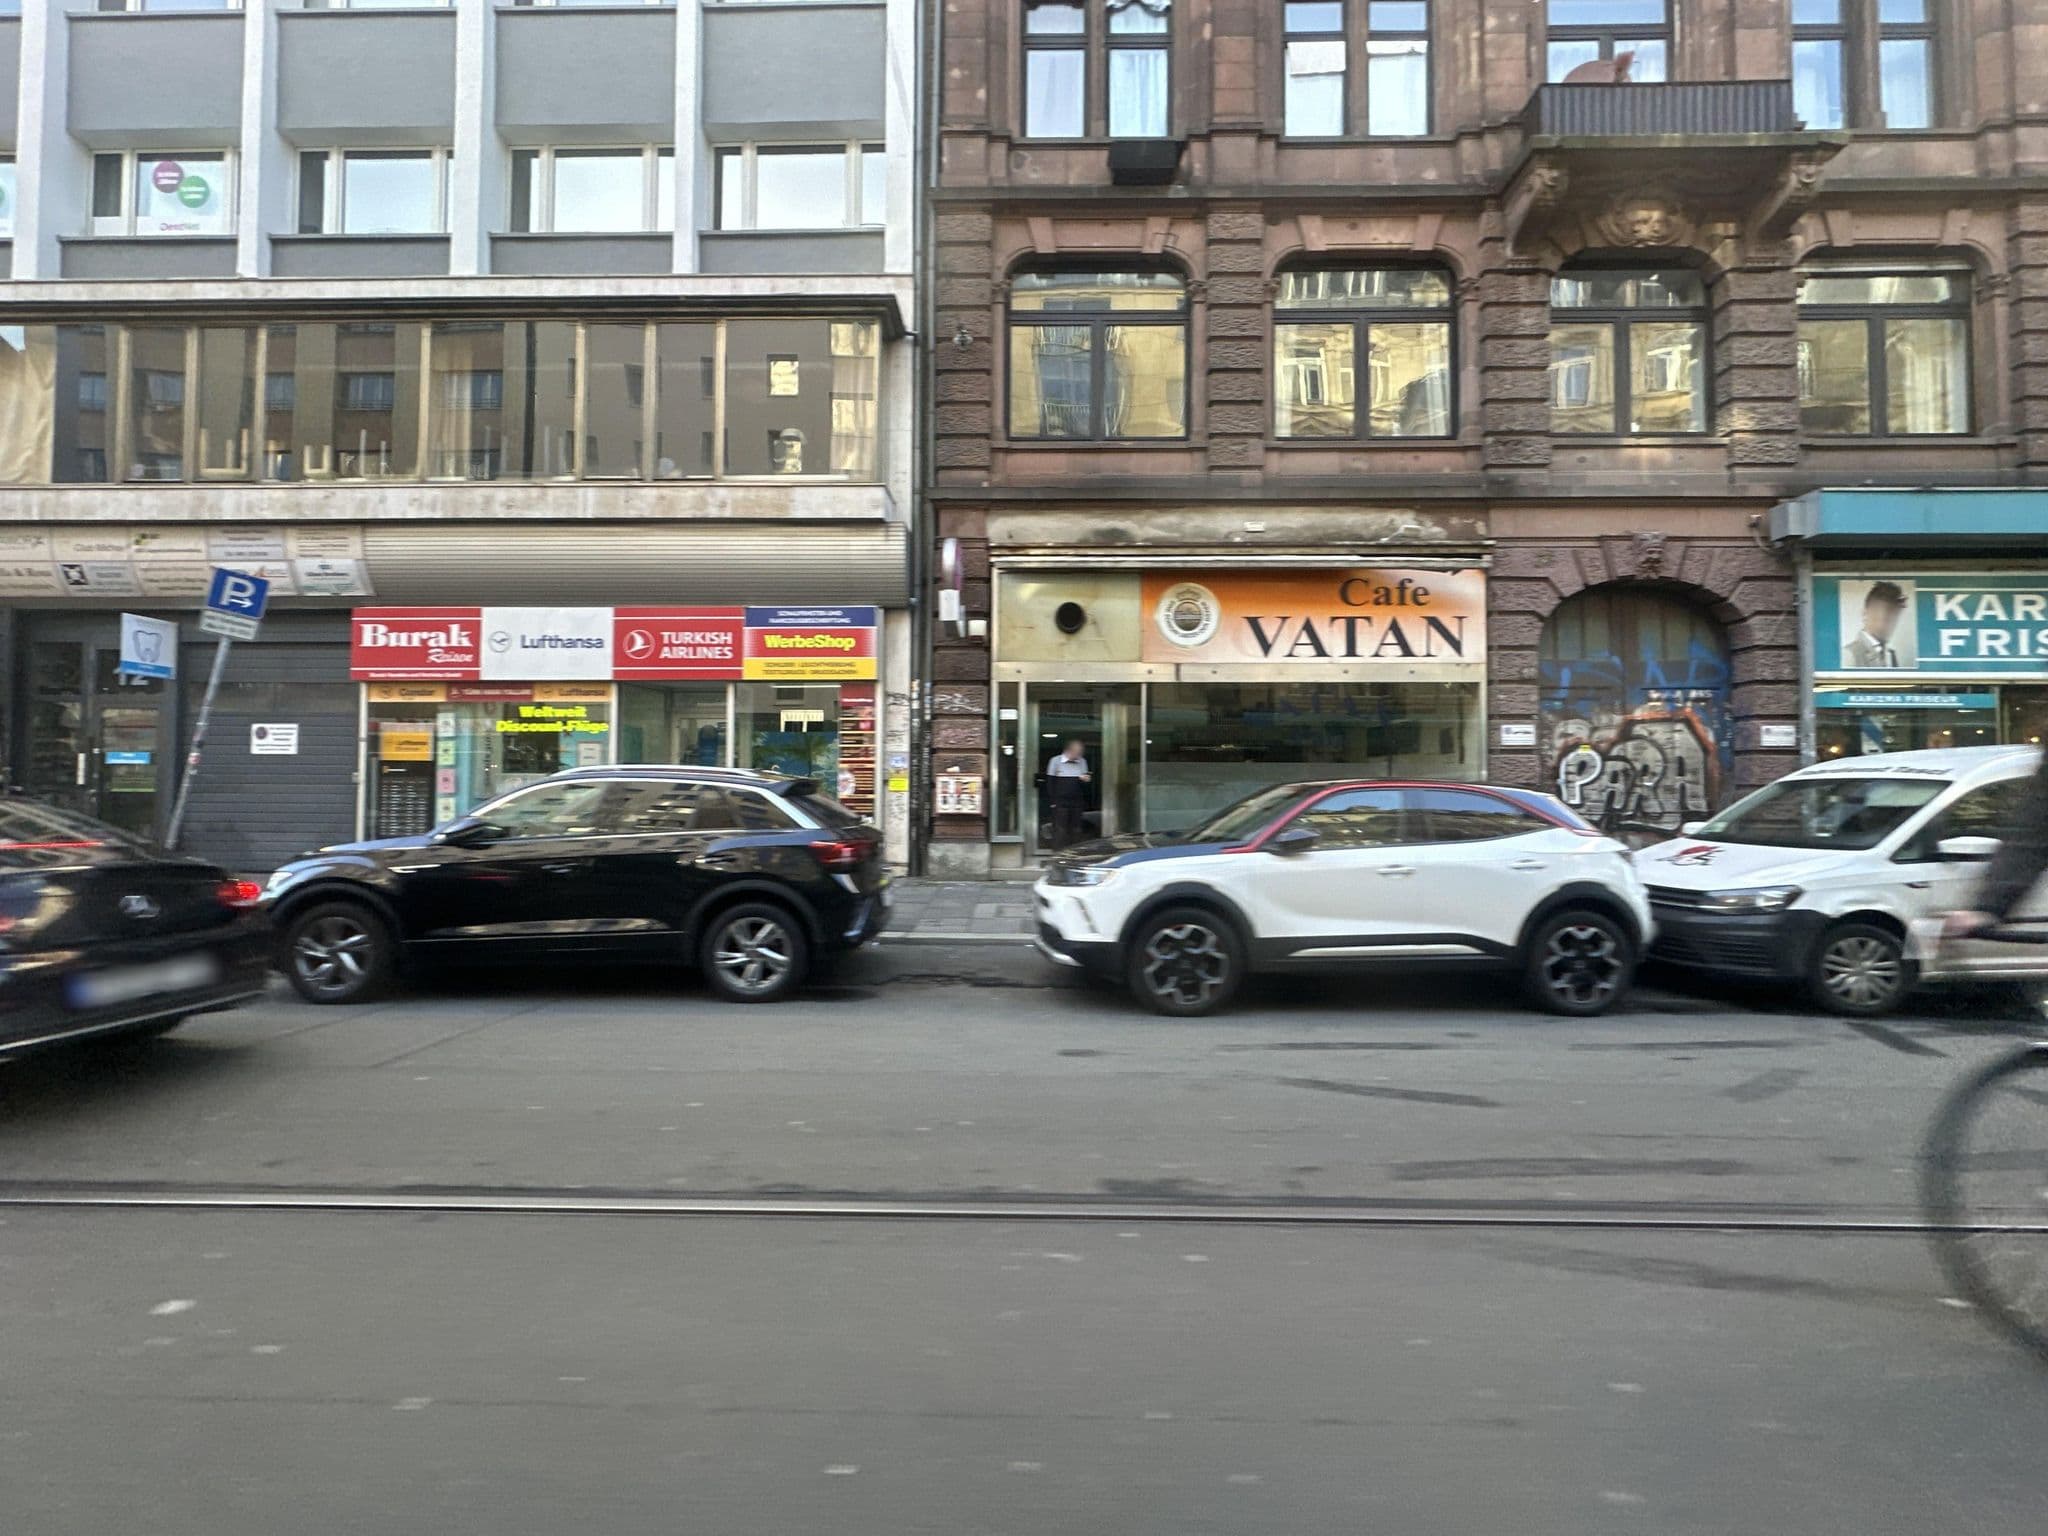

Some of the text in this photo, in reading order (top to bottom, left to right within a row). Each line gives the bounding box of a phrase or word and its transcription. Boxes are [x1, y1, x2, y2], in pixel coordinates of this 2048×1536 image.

[219, 575, 256, 606] P
[1338, 577, 1430, 607] Cafe
[1934, 593, 2048, 621] KAR
[358, 623, 473, 647] Burak
[520, 635, 604, 649] Lufthansa
[660, 631, 733, 645] TURKISH
[764, 634, 857, 651] WerbeShop
[1241, 616, 1469, 658] VATAN
[659, 646, 734, 659] AIRLINES
